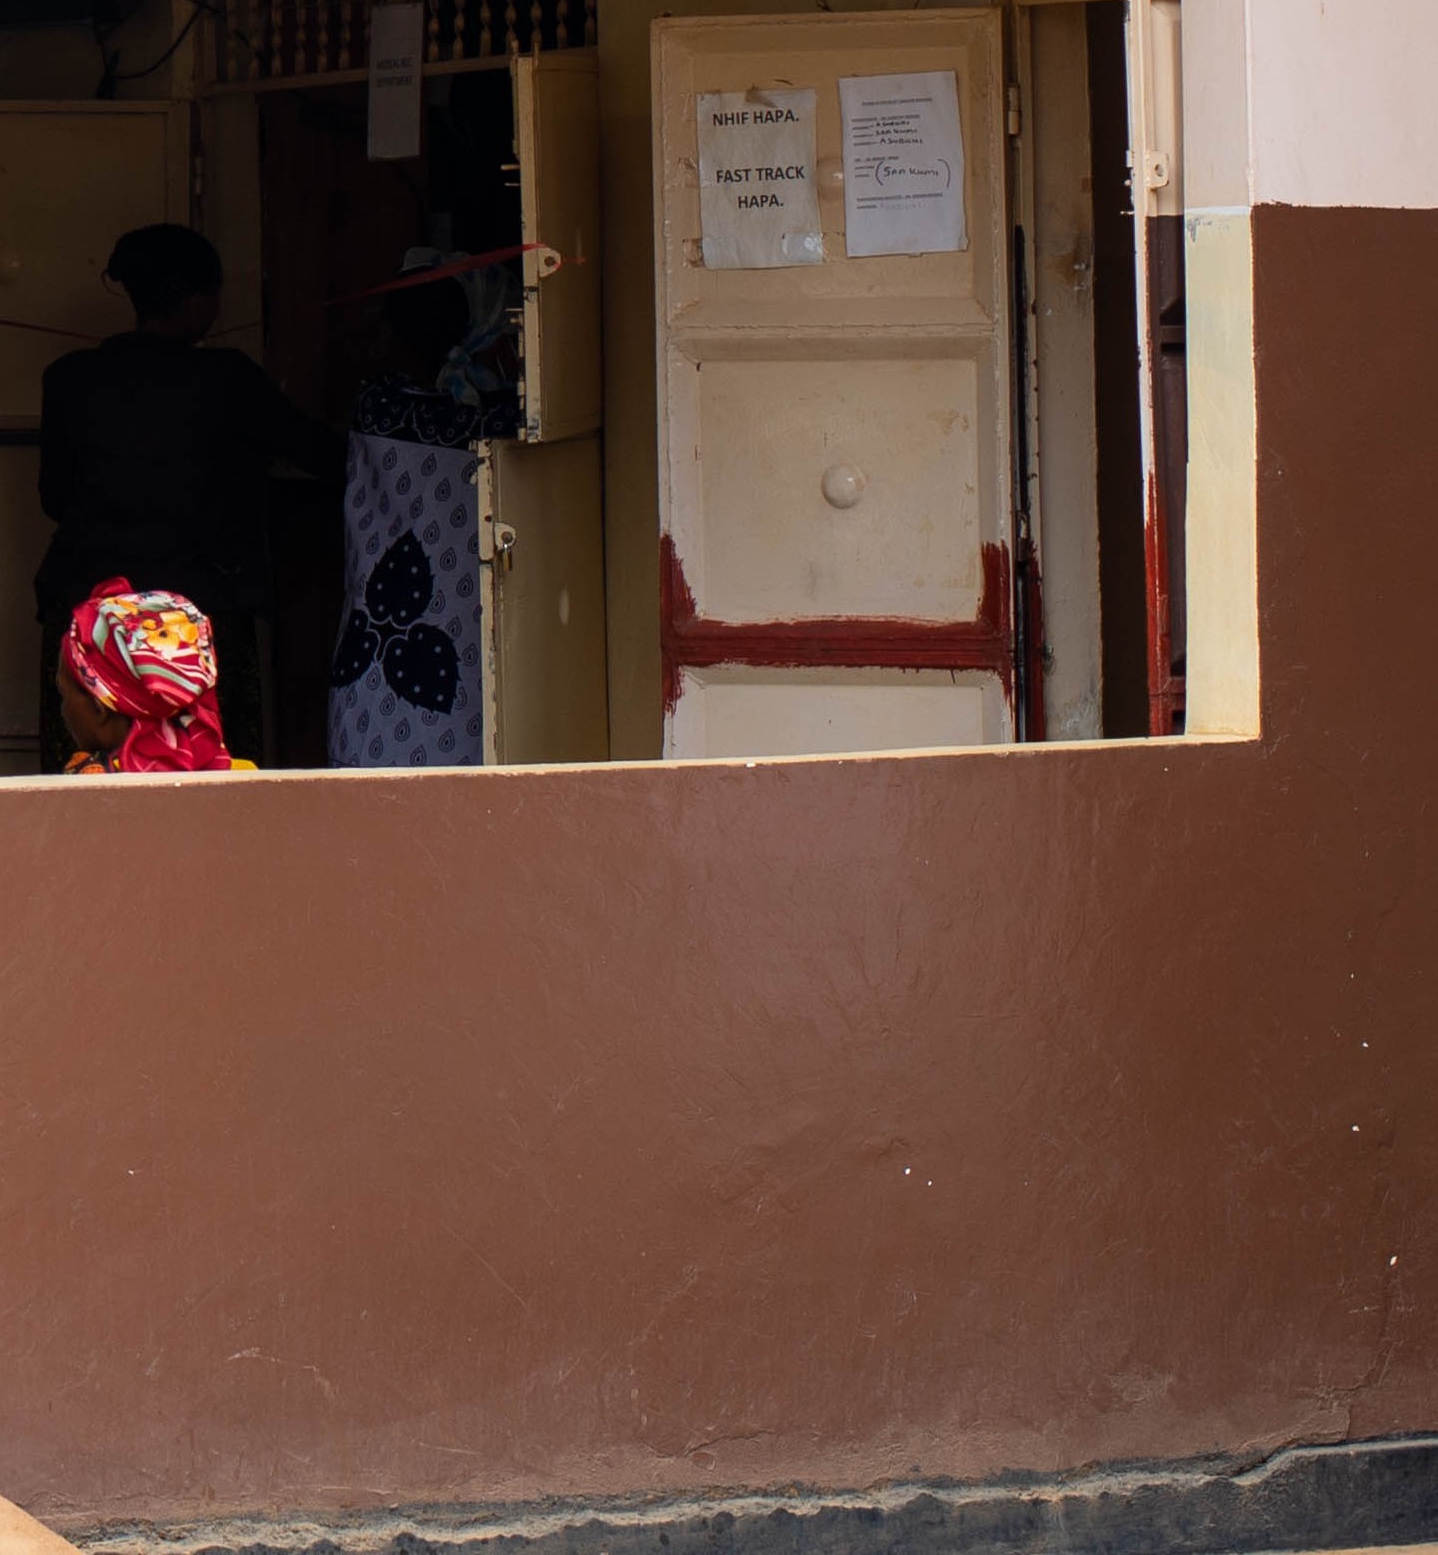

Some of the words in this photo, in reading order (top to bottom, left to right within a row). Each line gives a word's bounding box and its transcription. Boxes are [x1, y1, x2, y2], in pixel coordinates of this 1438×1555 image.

[712, 111, 749, 127] NHIF
[753, 109, 800, 124] HAPA.
[716, 168, 752, 183] FAST
[755, 165, 805, 181] TRACK
[737, 194, 784, 209] HAPA.
